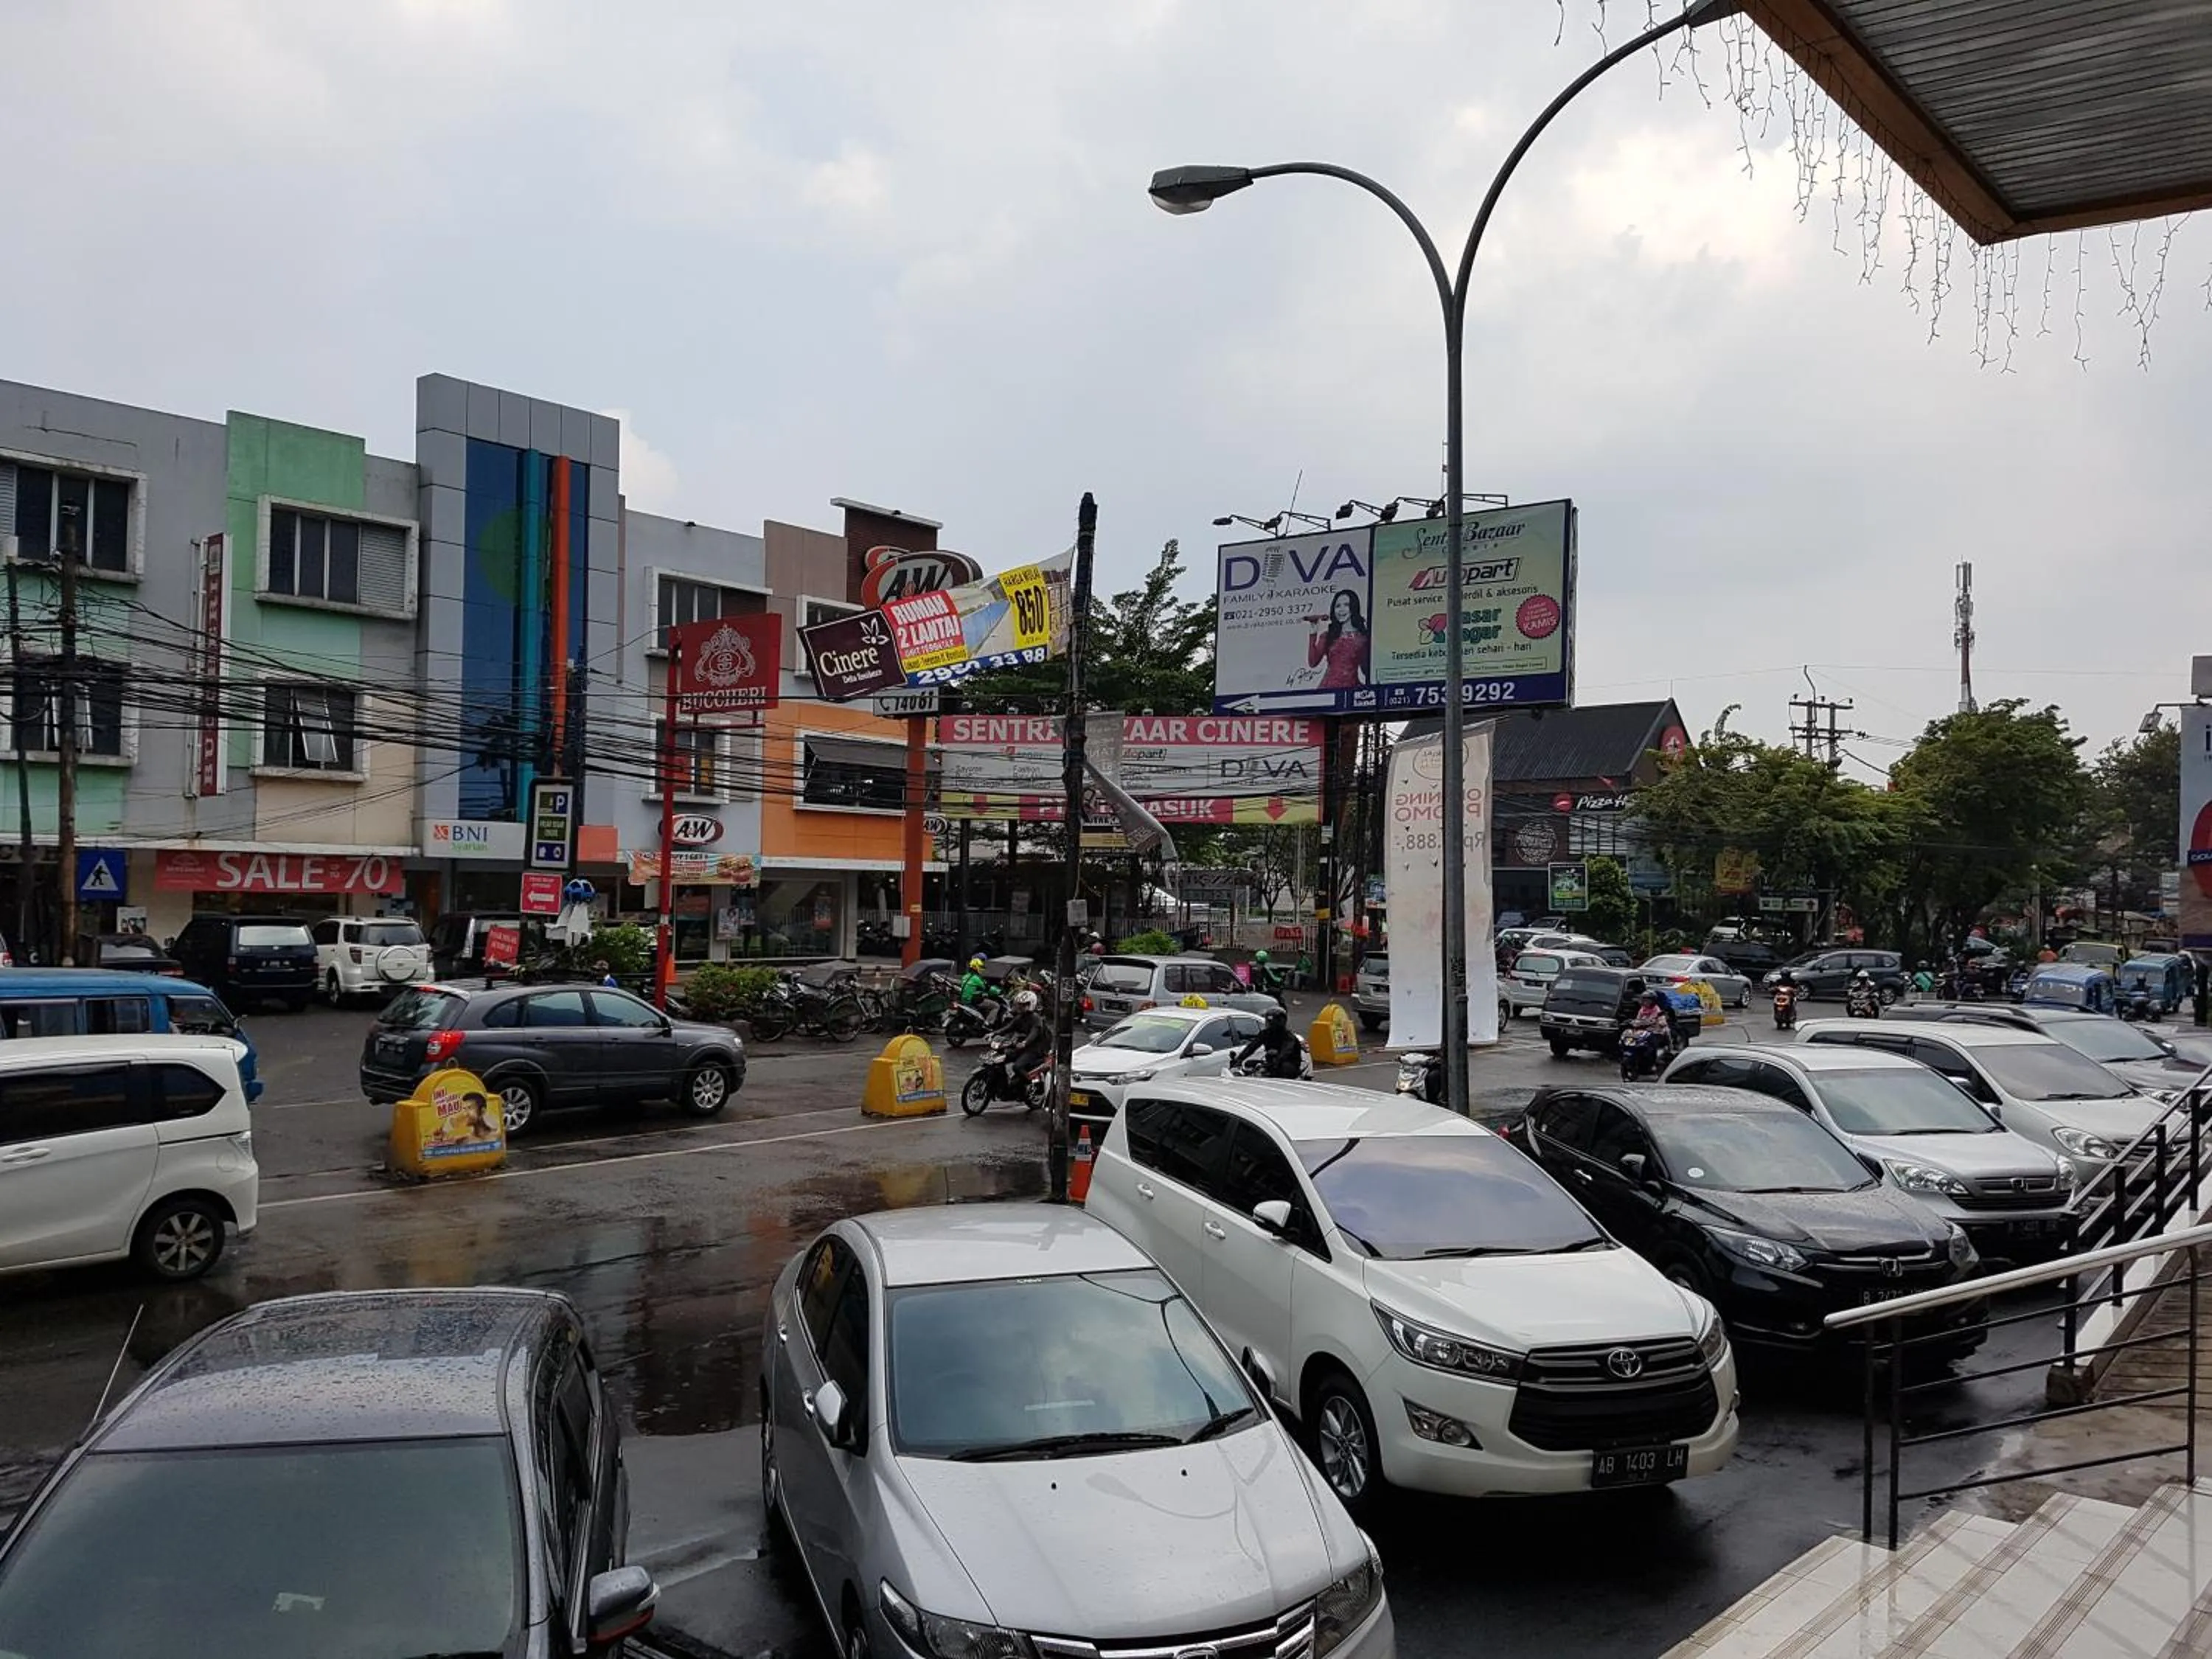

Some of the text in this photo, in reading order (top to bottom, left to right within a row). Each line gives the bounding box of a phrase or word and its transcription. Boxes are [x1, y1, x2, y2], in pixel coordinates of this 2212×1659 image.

[1463, 521, 1526, 543] Bazaar
[1409, 560, 1514, 590] Aupart
[1223, 585, 1337, 605] FAMILY KARAOKE
[1387, 597, 1411, 608] Pusat
[1486, 589, 1493, 599] &
[890, 594, 949, 626] RUMAH
[1461, 608, 1502, 625] asar
[897, 627, 909, 648] 2
[909, 614, 960, 646] LANTAI
[1461, 625, 1502, 644] gar
[819, 646, 880, 677] Cinere
[1391, 650, 1427, 661] Tersedia
[1477, 642, 1504, 653] sehari
[1514, 641, 1531, 652] hari
[681, 686, 768, 711] BUCCHERI
[1462, 681, 1516, 702] 9292
[1197, 720, 1310, 743] CINERE
[555, 794, 566, 812] P
[1141, 798, 1216, 818] ASUK
[1576, 795, 1613, 810] Pizza
[452, 825, 488, 842] BNI
[216, 852, 327, 890] SALE
[344, 856, 389, 891] 70
[1598, 1447, 1684, 1474] AB 1403 LH
